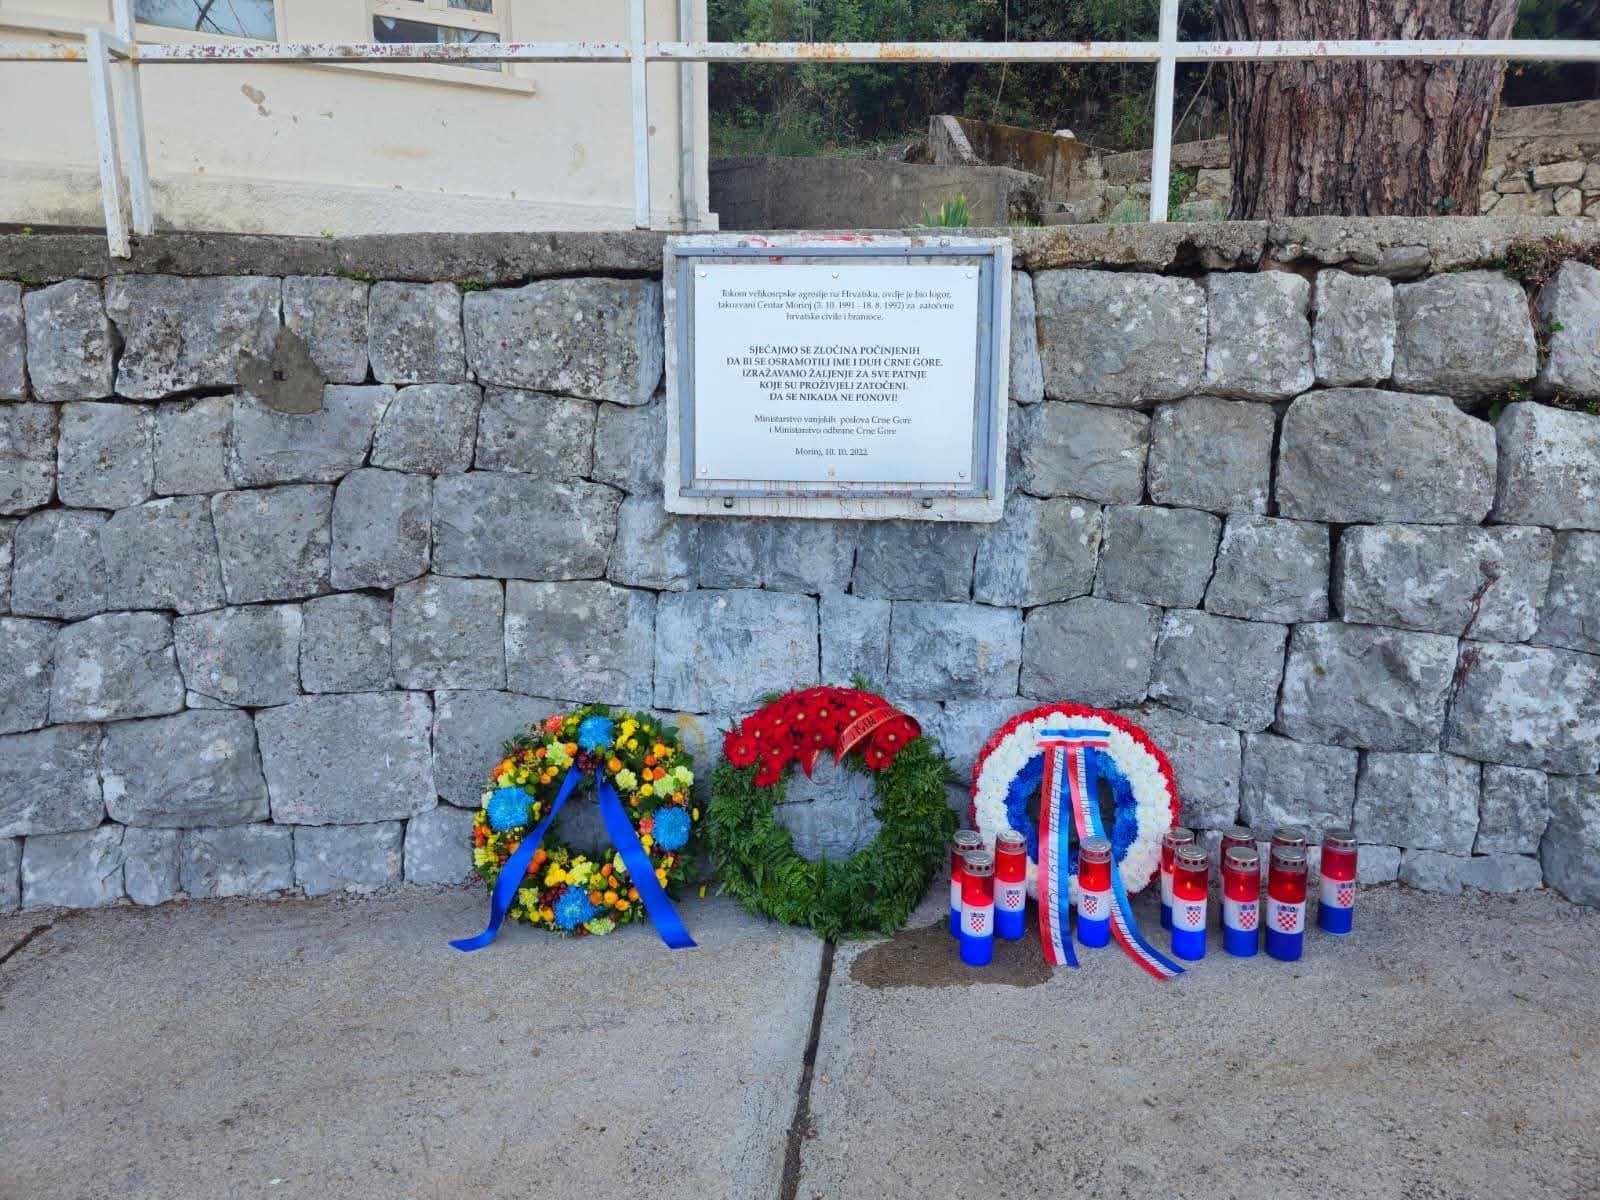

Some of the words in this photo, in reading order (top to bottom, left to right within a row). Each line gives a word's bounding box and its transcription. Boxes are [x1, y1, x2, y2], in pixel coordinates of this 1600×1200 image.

[722, 288, 748, 298] Tokom
[749, 288, 797, 300] velikosrpske
[798, 288, 829, 300] agresije
[830, 290, 840, 298] na
[842, 288, 880, 299] Hrvatsku,
[882, 289, 905, 300] ovdje
[906, 289, 914, 300] je
[914, 289, 928, 299] bio
[929, 289, 952, 301] logor,
[718, 301, 756, 310] takozvani
[757, 301, 784, 310] Centar
[786, 301, 813, 311] Morinj
[839, 301, 855, 310] 1991
[786, 312, 821, 321] hrvatske
[821, 312, 843, 321] civile
[749, 344, 799, 356] SJEĆAJMO
[800, 345, 812, 355] SE
[813, 344, 858, 355] ZLOČINA
[860, 344, 920, 356] POČINJENIH
[727, 357, 741, 366] DA
[743, 357, 753, 366] BI
[754, 357, 767, 366] SE
[768, 358, 830, 367] OSRAMOTILI
[832, 358, 851, 367] IME
[859, 358, 882, 367] DUH
[883, 358, 911, 367] CRNE
[912, 358, 944, 367] GORE.
[742, 368, 807, 378] IZRAŽAVAMO
[809, 368, 855, 380] ŽALJENJE
[855, 370, 869, 379] ZA
[871, 370, 891, 379] SVE
[892, 370, 928, 380] PATNJE
[759, 381, 784, 391] KOJE
[784, 381, 798, 390] SU
[799, 380, 854, 391] PROŽIVJELI
[769, 393, 784, 401] DA
[786, 393, 799, 401] SE
[799, 393, 840, 402] NIKADA
[840, 393, 856, 402] NE
[856, 393, 898, 402] PONOVI!
[754, 414, 803, 423] Ministarstvo
[804, 415, 836, 425] vanjskih
[840, 415, 870, 425] poslova
[871, 416, 891, 424] Crne
[892, 416, 912, 424] Gore
[775, 426, 822, 434] Ministarstvo
[823, 426, 855, 435] odbrane
[856, 427, 876, 435] Crne
[877, 427, 897, 435] Gore
[825, 448, 836, 456] 10.
[838, 448, 849, 456] 10.
